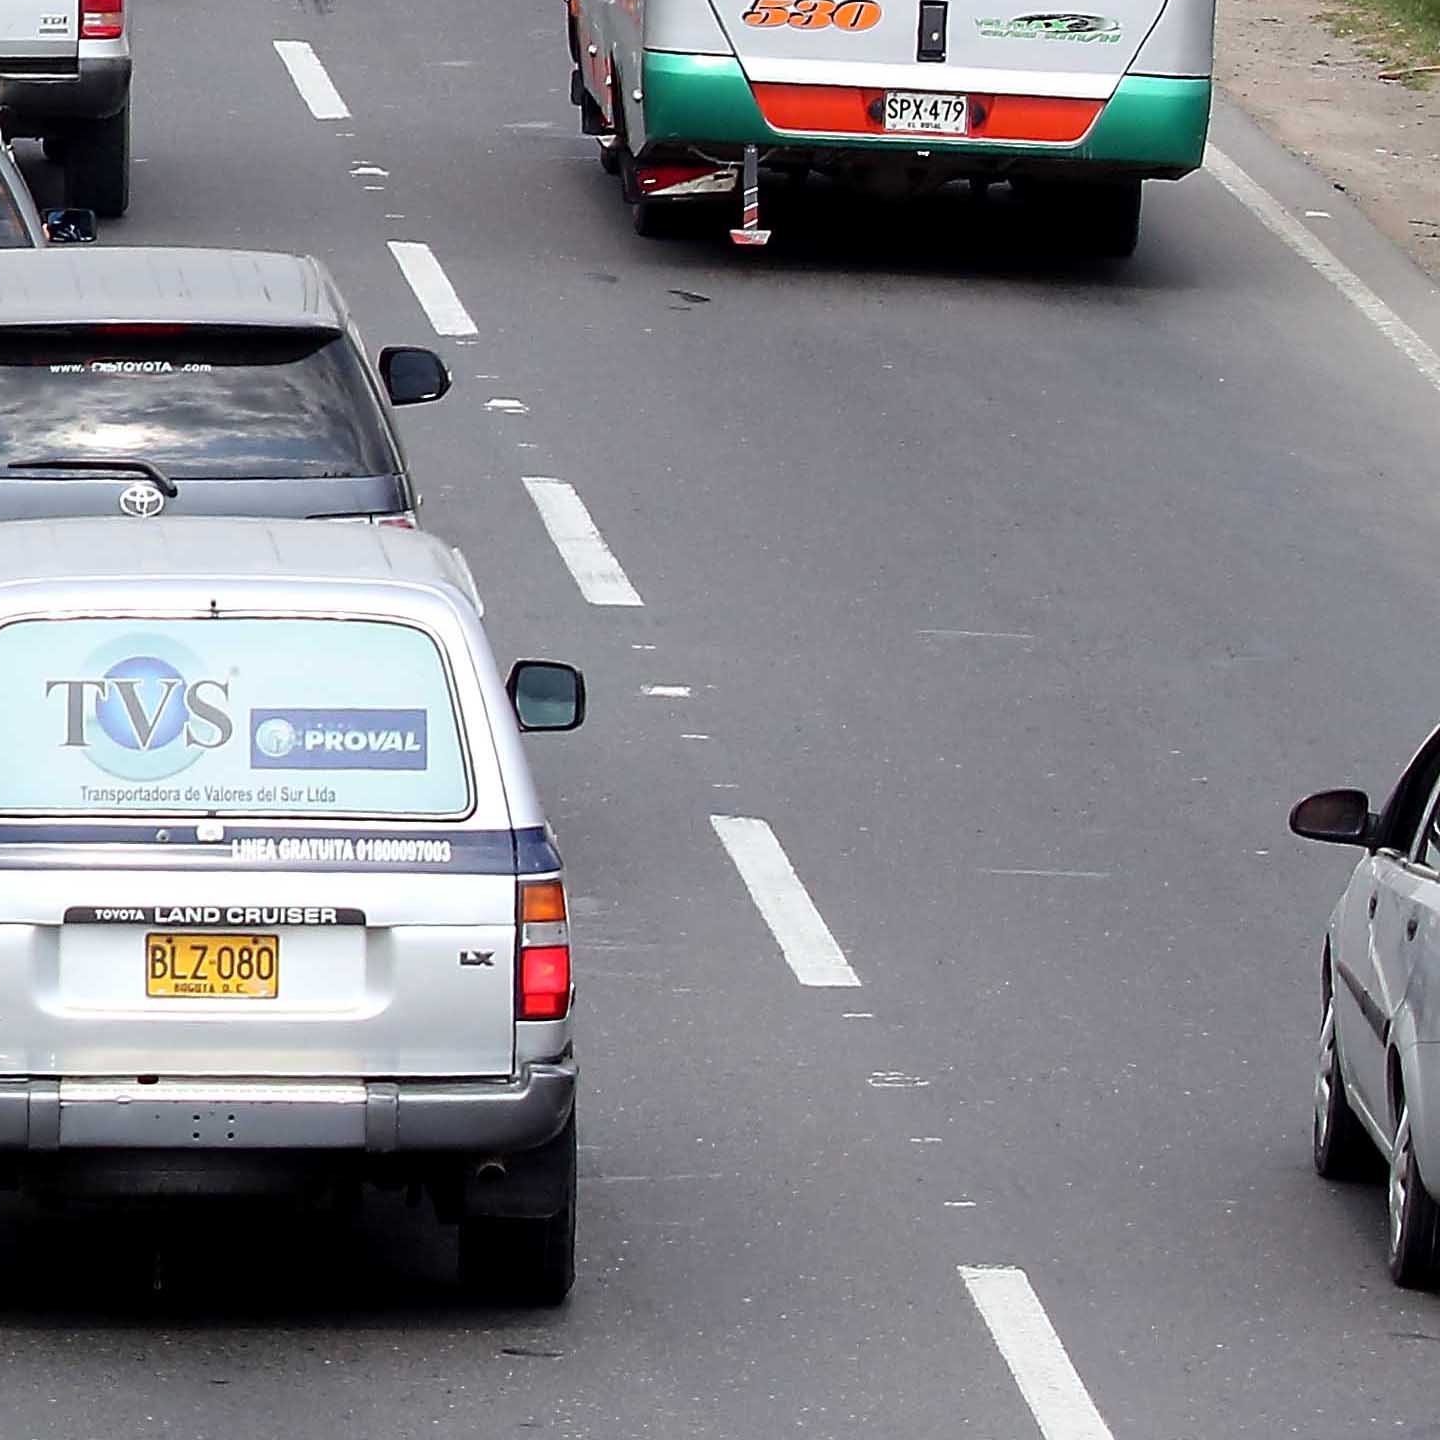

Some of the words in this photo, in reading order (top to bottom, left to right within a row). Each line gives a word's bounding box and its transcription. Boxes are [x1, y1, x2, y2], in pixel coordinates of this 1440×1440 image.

[46, 680, 232, 748] TVS
[305, 730, 421, 751] PROVAL
[80, 786, 180, 804] Transportadora
[185, 786, 200, 802] de
[204, 786, 253, 802] Valores
[257, 786, 277, 802] del
[280, 786, 303, 802] Sur
[307, 787, 337, 802] Ltda
[279, 839, 355, 861] GRATUITA
[94, 909, 145, 921] TOYOTA
[154, 907, 221, 923] LAND
[226, 907, 337, 924] CRUISER
[150, 944, 274, 981] BLZ-080
[460, 951, 495, 966] LX
